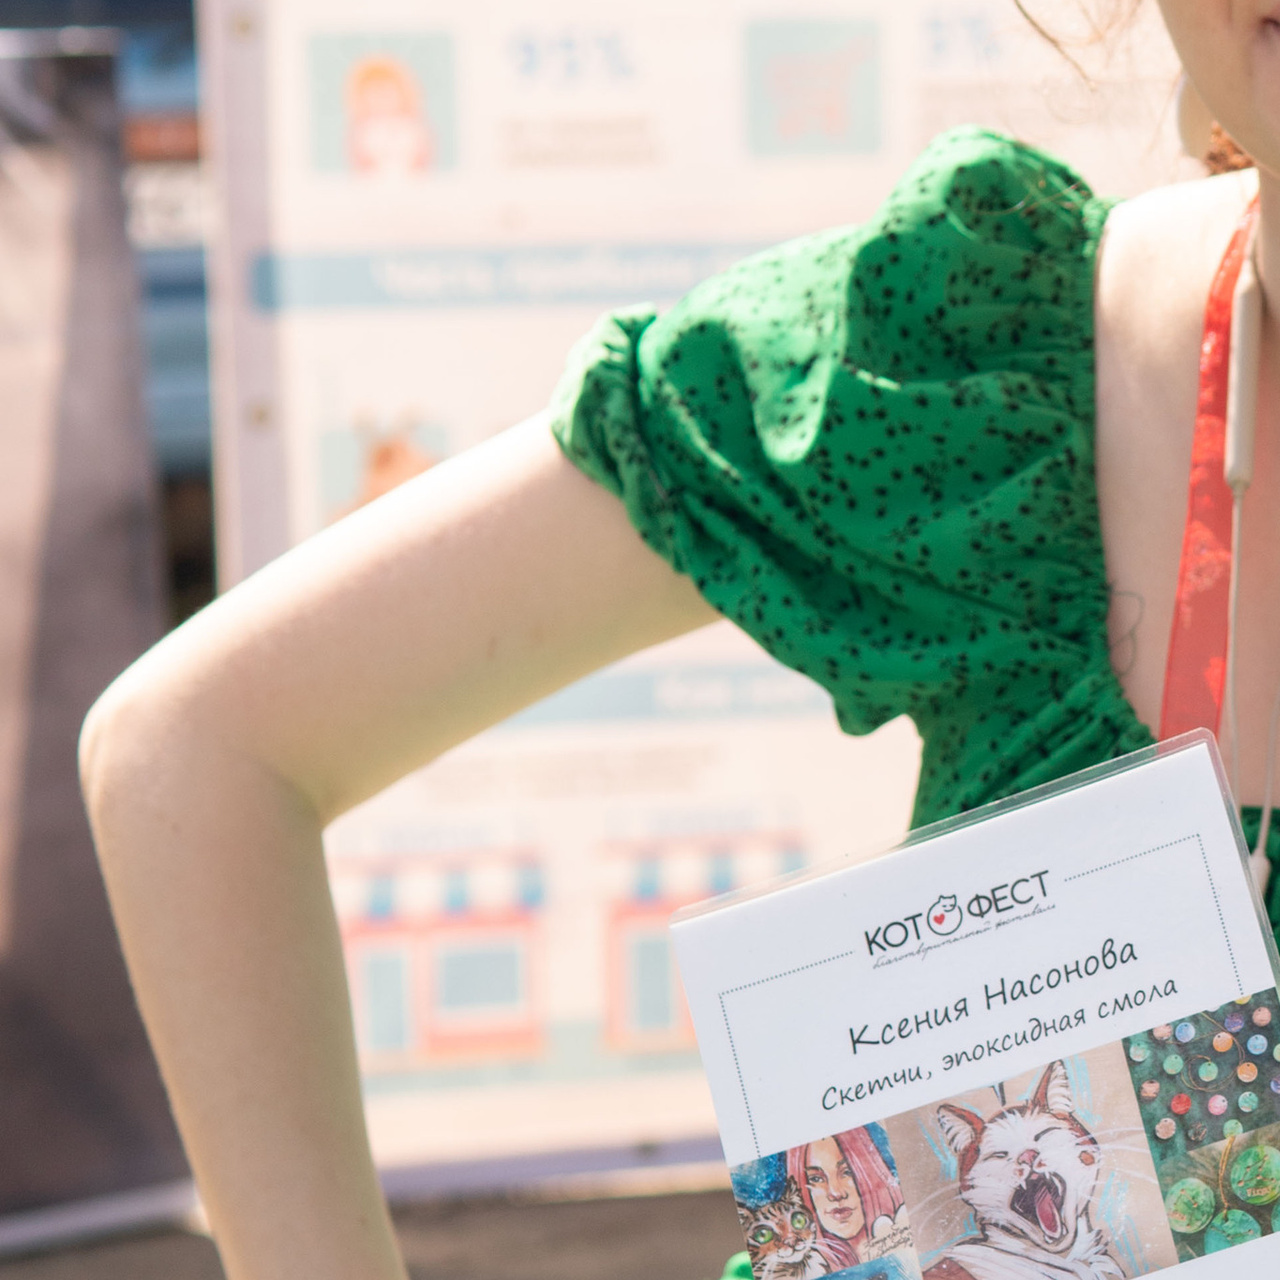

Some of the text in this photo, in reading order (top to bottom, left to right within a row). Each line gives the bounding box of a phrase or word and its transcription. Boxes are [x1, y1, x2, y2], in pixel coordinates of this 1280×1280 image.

[820, 978, 1179, 1111] Скетчи, эпоксидная смола
[848, 937, 1139, 1056] Ксения Насонова
